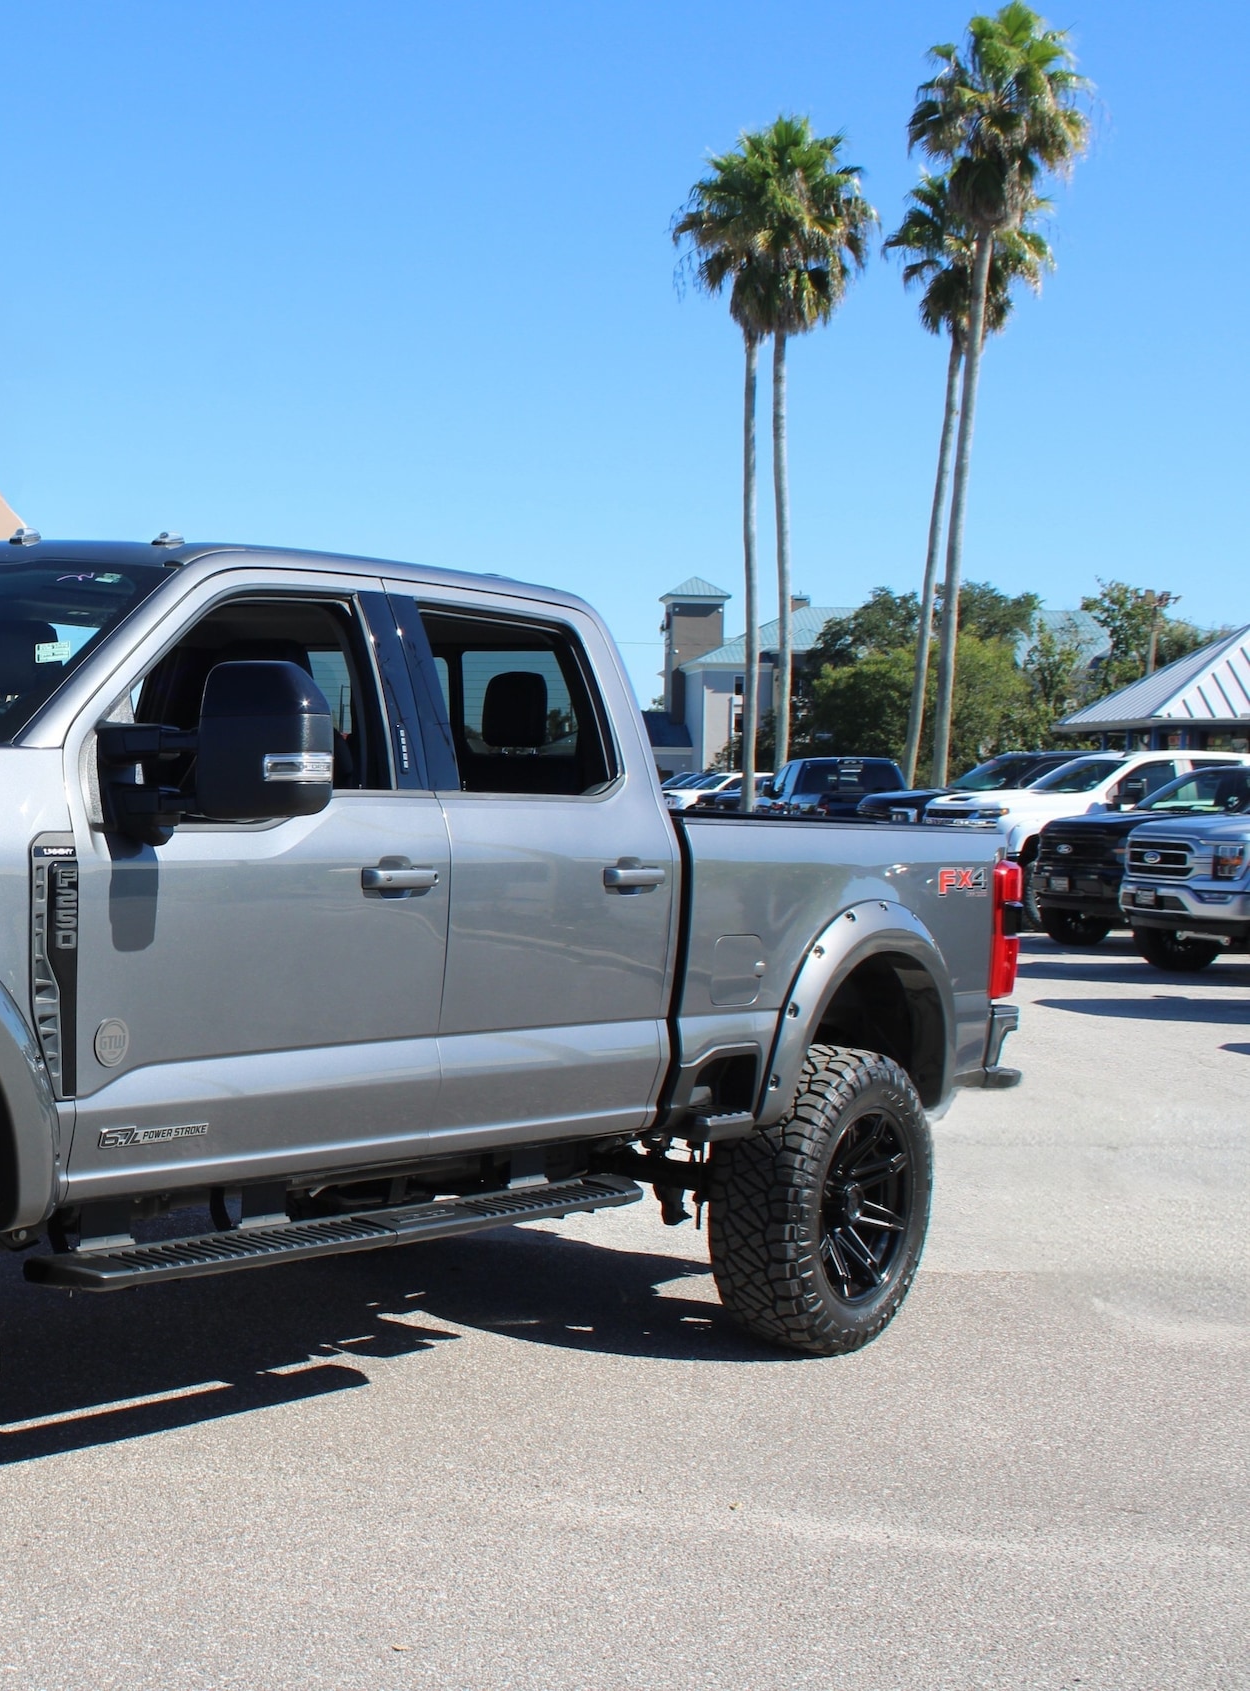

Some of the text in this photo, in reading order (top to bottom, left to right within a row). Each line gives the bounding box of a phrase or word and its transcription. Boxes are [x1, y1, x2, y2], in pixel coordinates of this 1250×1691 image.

[938, 867, 987, 897] FX4
[100, 1035, 126, 1050] GTW
[99, 1126, 141, 1148] 6.7L
[142, 1130, 172, 1140] POWER
[174, 1125, 207, 1137] STROKE
